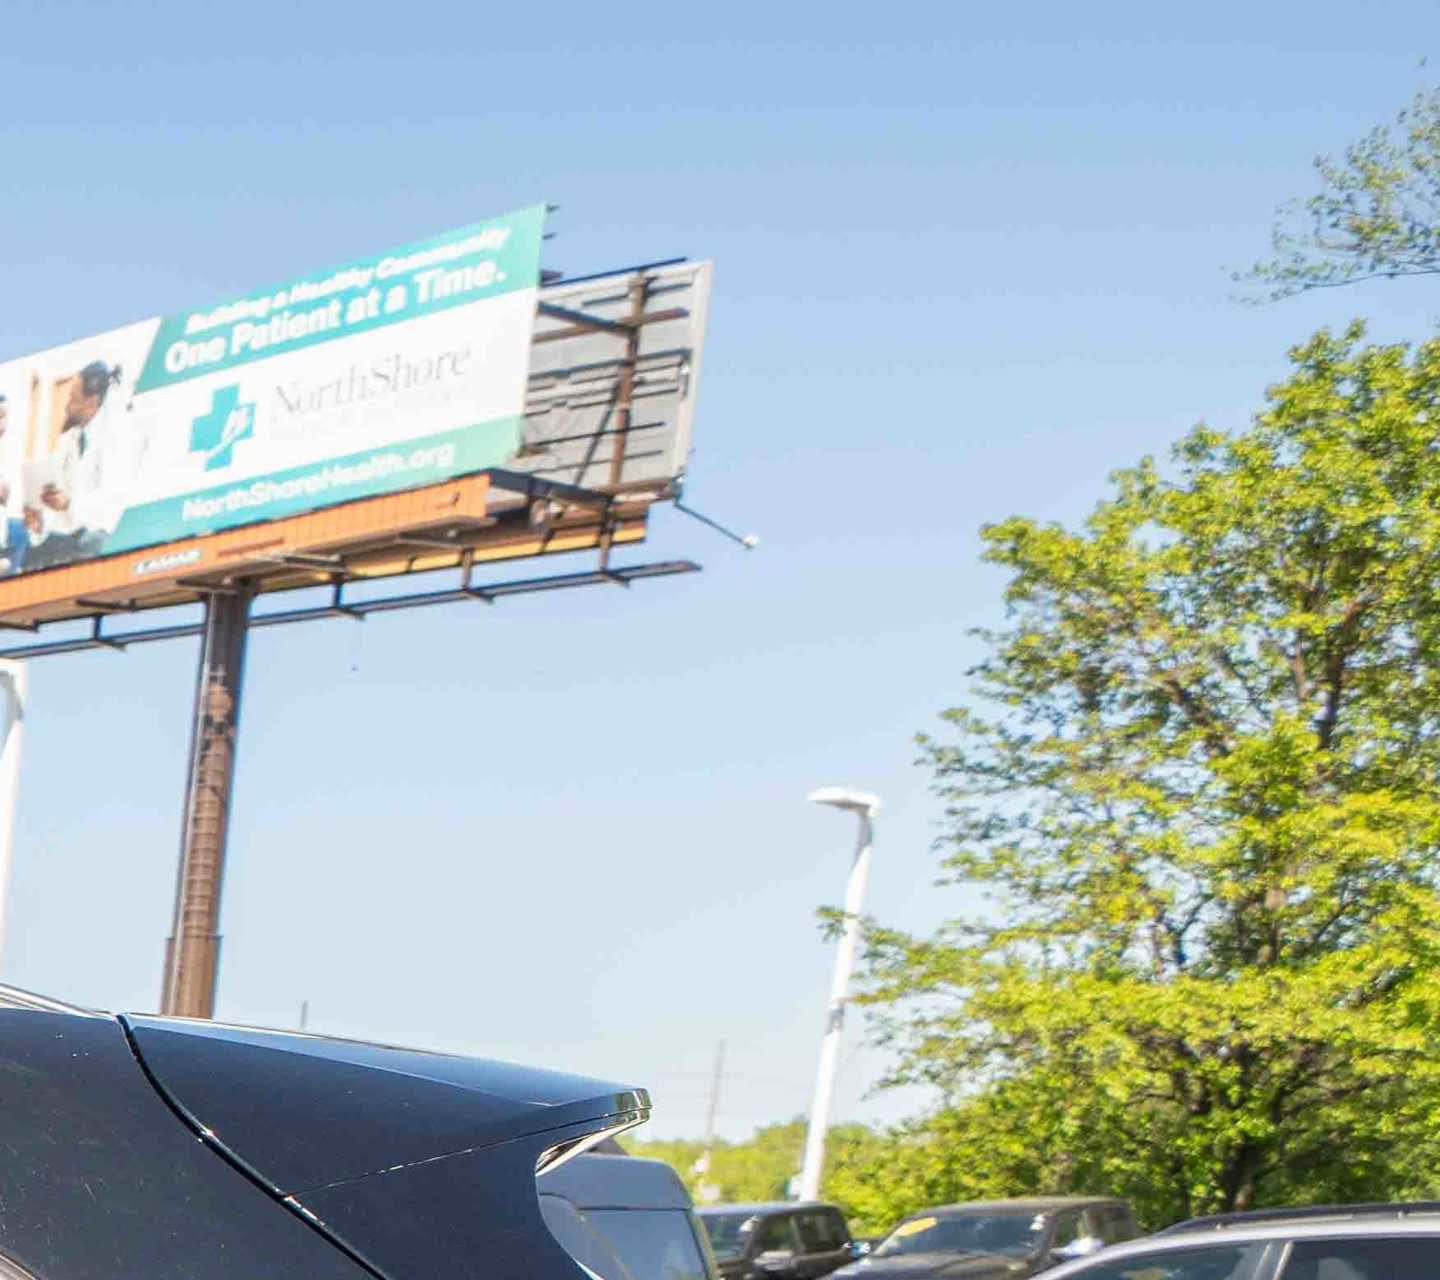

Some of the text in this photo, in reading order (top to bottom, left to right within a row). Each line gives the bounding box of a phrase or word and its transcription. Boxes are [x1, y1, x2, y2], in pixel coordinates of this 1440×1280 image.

[164, 259, 507, 375] One Patient at a Time.
[273, 349, 469, 415] NorthShore
